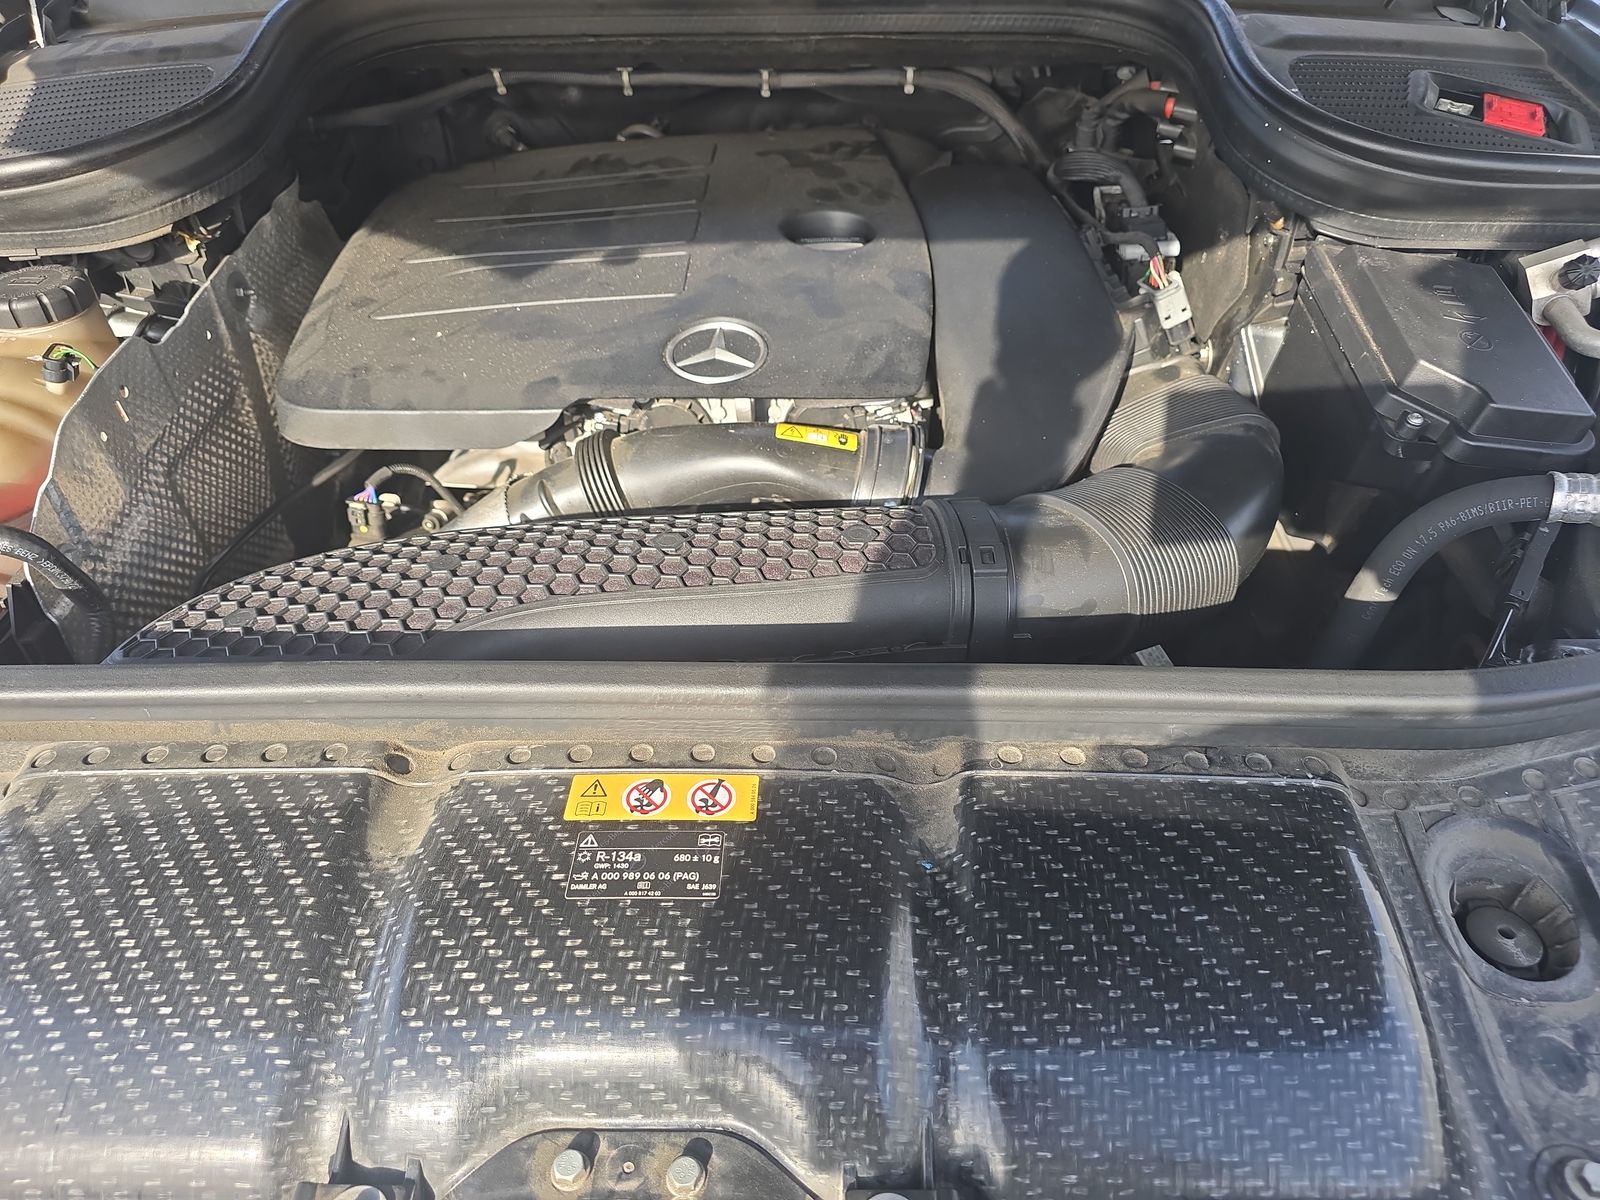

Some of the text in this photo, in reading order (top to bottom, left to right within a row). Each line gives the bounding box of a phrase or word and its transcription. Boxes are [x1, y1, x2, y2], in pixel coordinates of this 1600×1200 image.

[1389, 559, 1406, 577] ECO
[1402, 546, 1418, 561] DN
[1415, 525, 1438, 547] 17.5
[595, 850, 642, 862] R-134a
[673, 853, 691, 862] 680
[701, 854, 712, 862] 10
[713, 855, 720, 864] g
[591, 871, 700, 882] A 000 989 06 06 (PAG)
